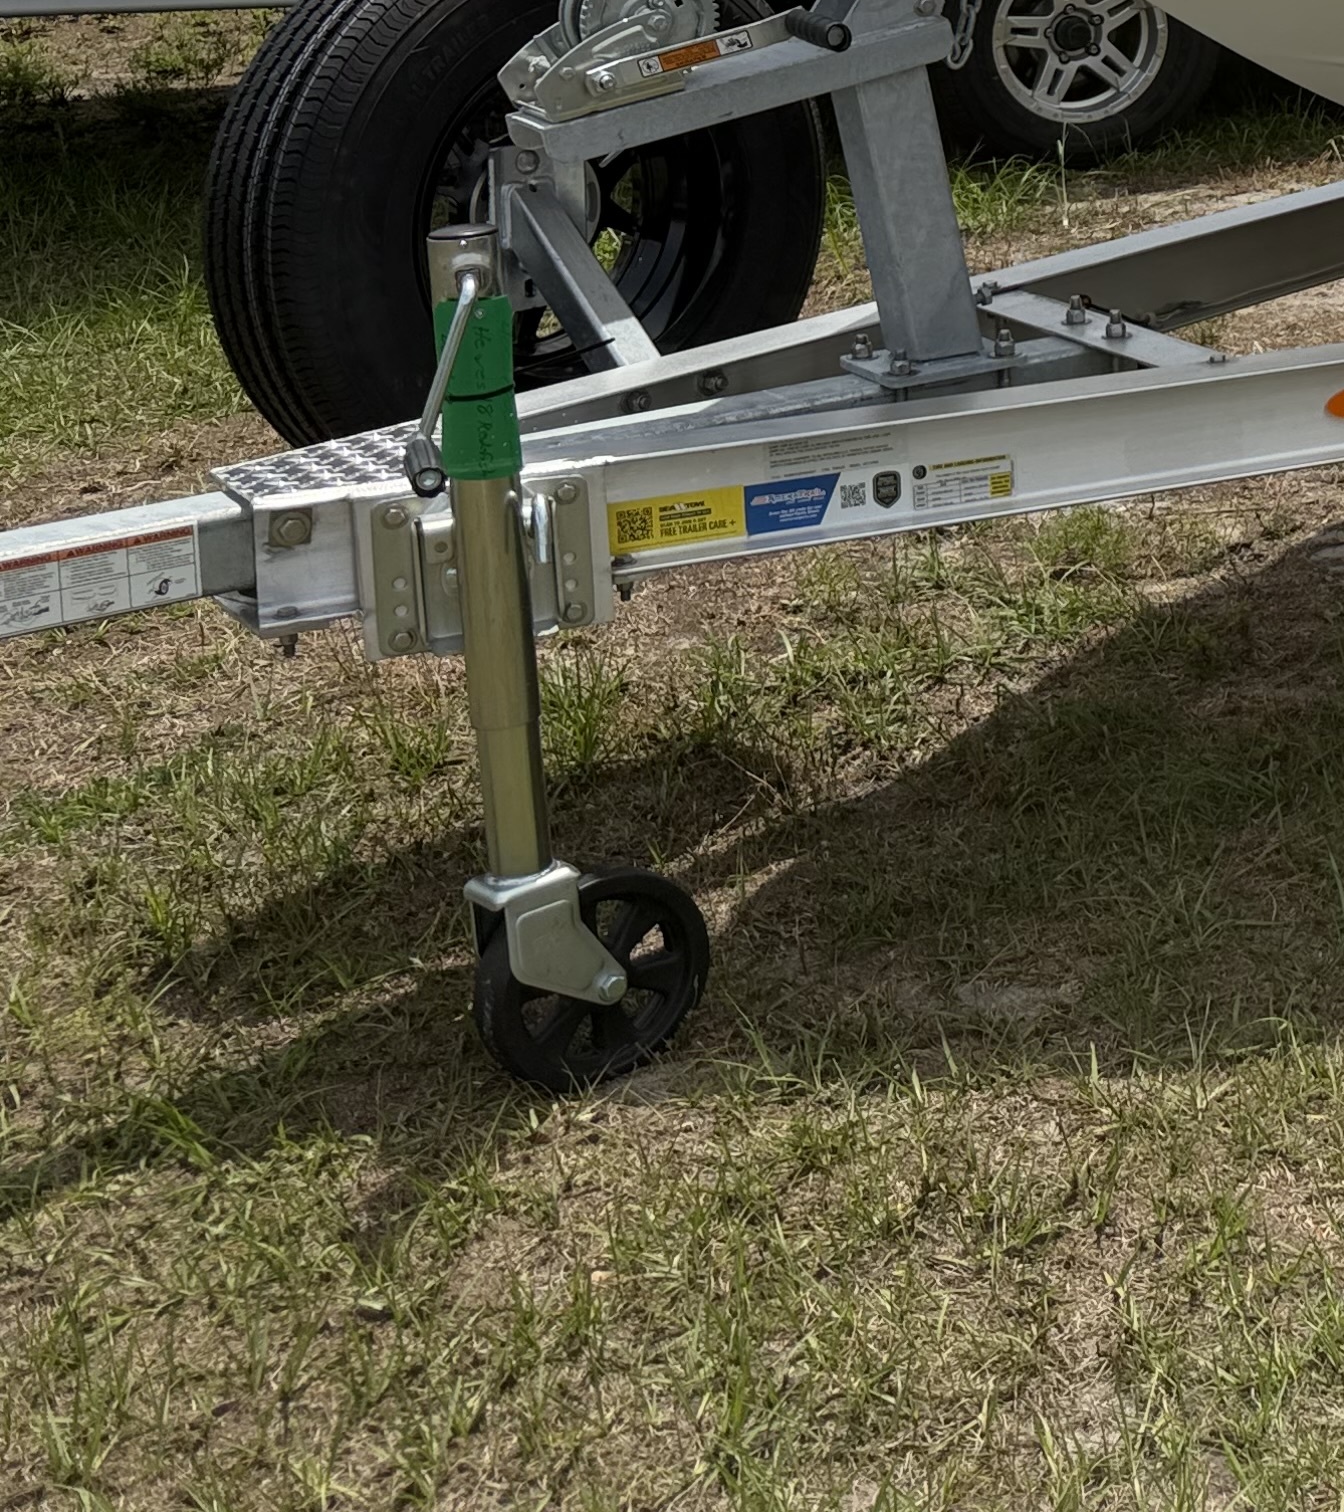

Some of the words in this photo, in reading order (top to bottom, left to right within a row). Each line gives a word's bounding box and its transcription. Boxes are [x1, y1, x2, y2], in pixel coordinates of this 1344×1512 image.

[141, 525, 192, 544] WARNING
[660, 527, 678, 538] FREE
[679, 522, 708, 536] TRAILER
[709, 519, 728, 531] CARE
[74, 538, 122, 557] WARNING
[2, 554, 51, 571] WARNING
